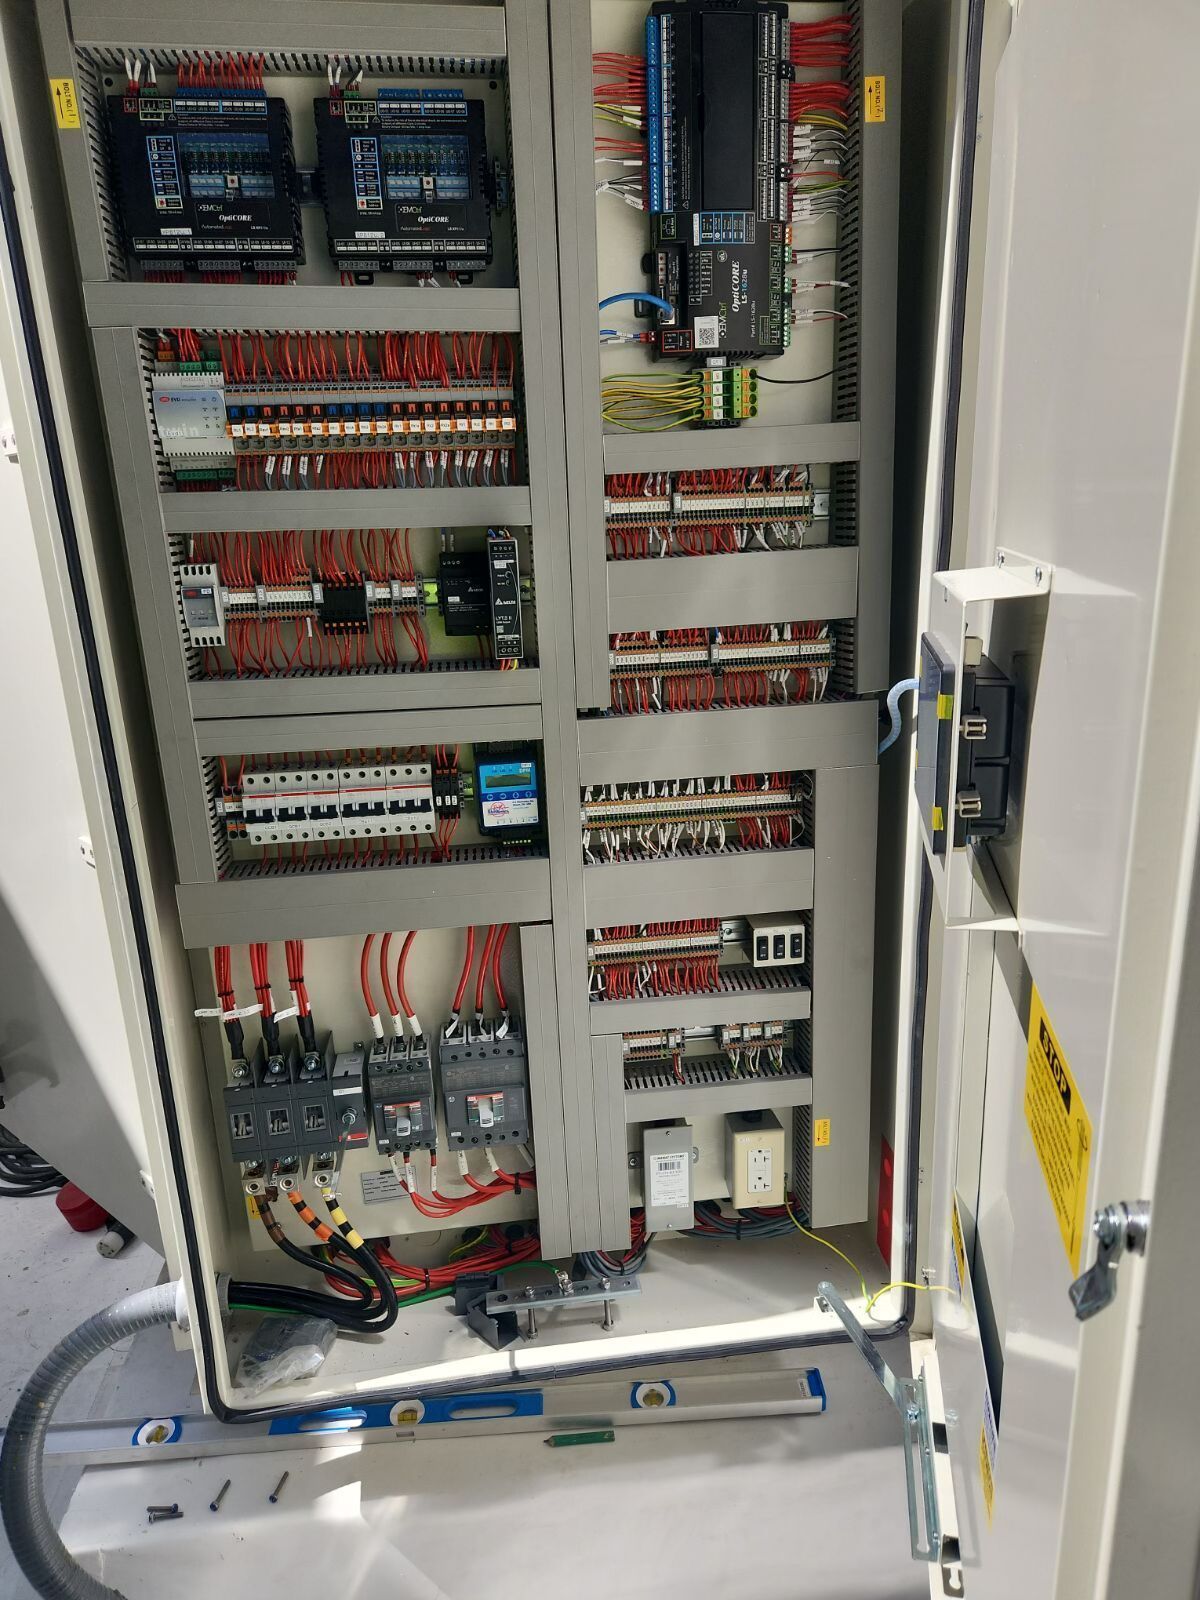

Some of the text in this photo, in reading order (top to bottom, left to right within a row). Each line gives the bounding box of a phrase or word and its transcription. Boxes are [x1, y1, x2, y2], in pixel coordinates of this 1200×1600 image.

[218, 214, 253, 223] OptiCORE
[418, 215, 449, 224] OptiCORE
[731, 260, 740, 312] OptiCORE
[1042, 1030, 1067, 1093] STOP
